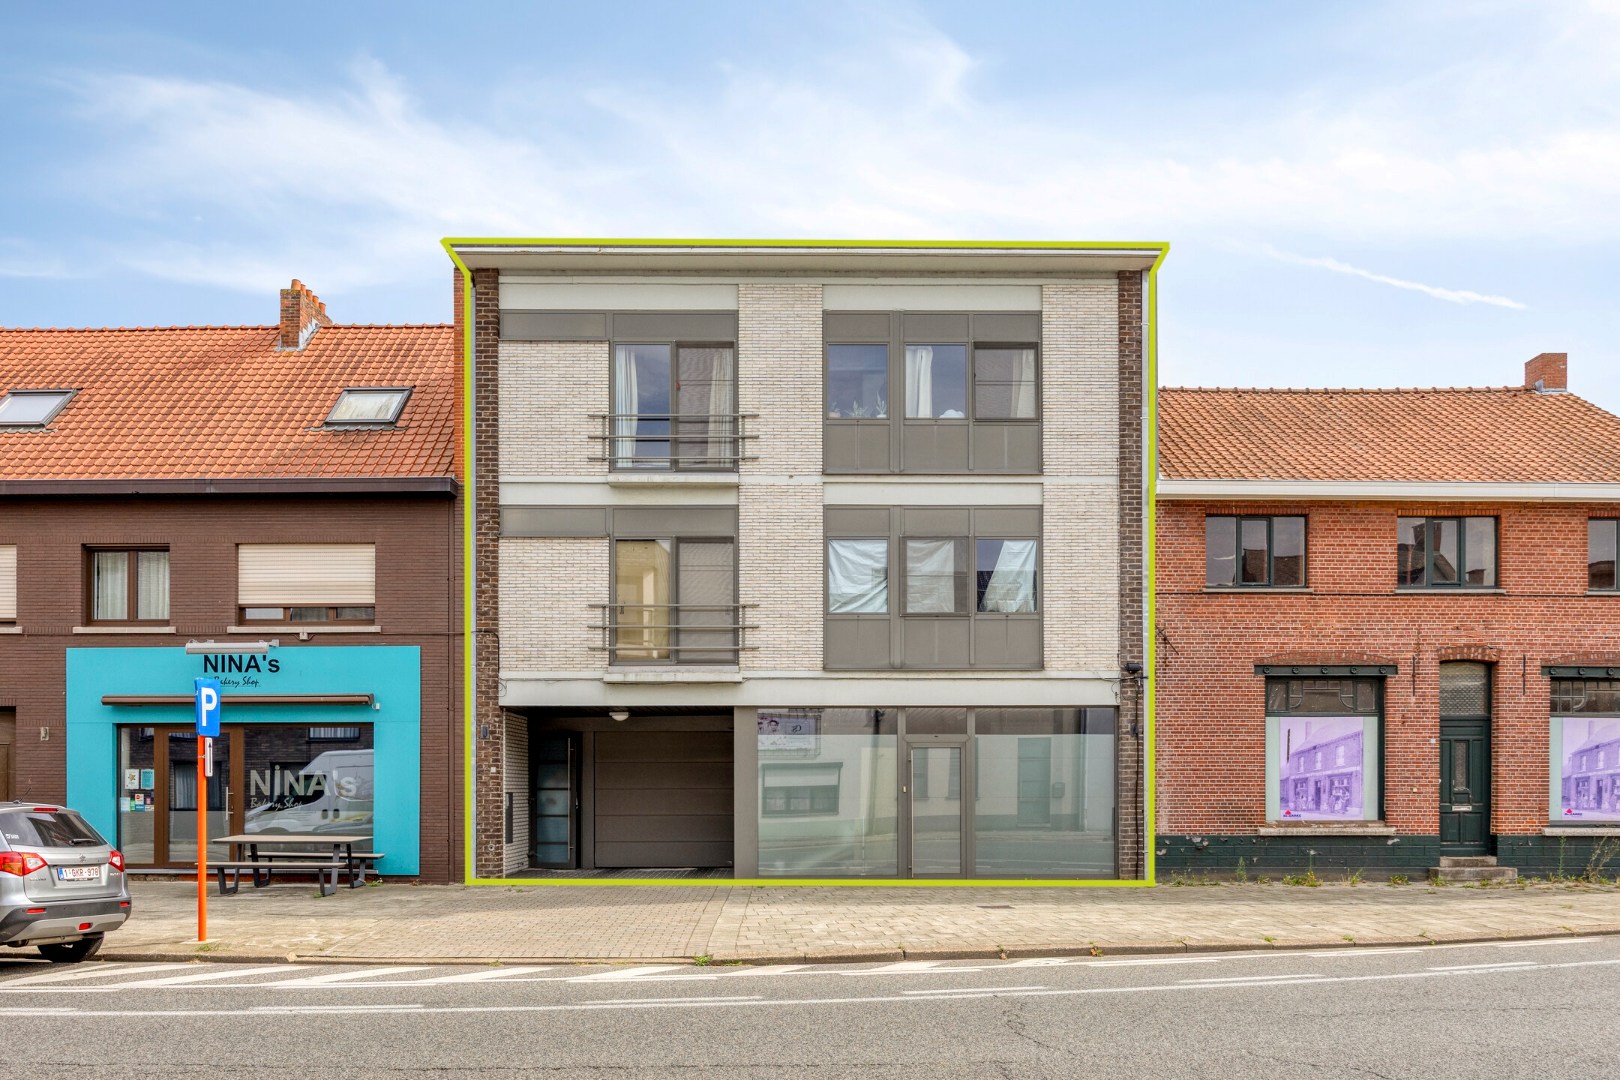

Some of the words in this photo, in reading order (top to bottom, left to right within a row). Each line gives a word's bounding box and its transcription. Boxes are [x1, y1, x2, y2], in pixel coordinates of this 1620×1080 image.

[203, 654, 280, 673] NINA's
[242, 675, 260, 688] Shop
[201, 686, 218, 727] P
